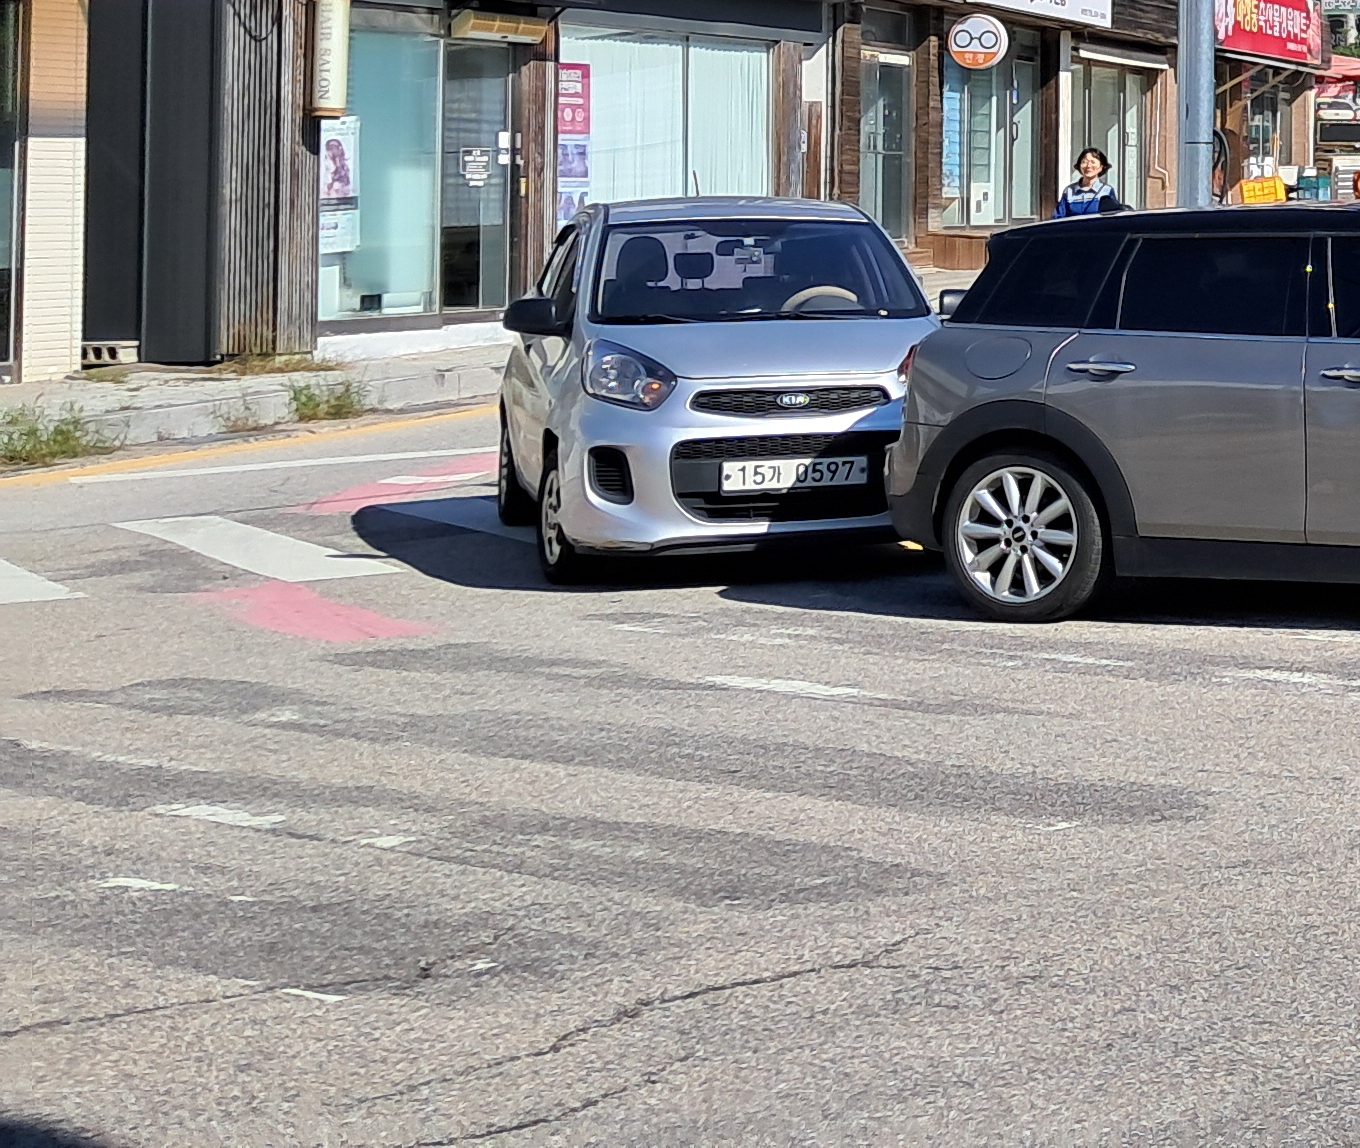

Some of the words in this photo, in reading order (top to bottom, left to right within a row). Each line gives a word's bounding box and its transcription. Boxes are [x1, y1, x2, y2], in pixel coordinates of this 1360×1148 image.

[319, 1, 334, 43] HAIR
[317, 47, 333, 101] SALON
[782, 393, 807, 405] KIA
[738, 465, 782, 486] 15가
[796, 460, 856, 483] 0597
